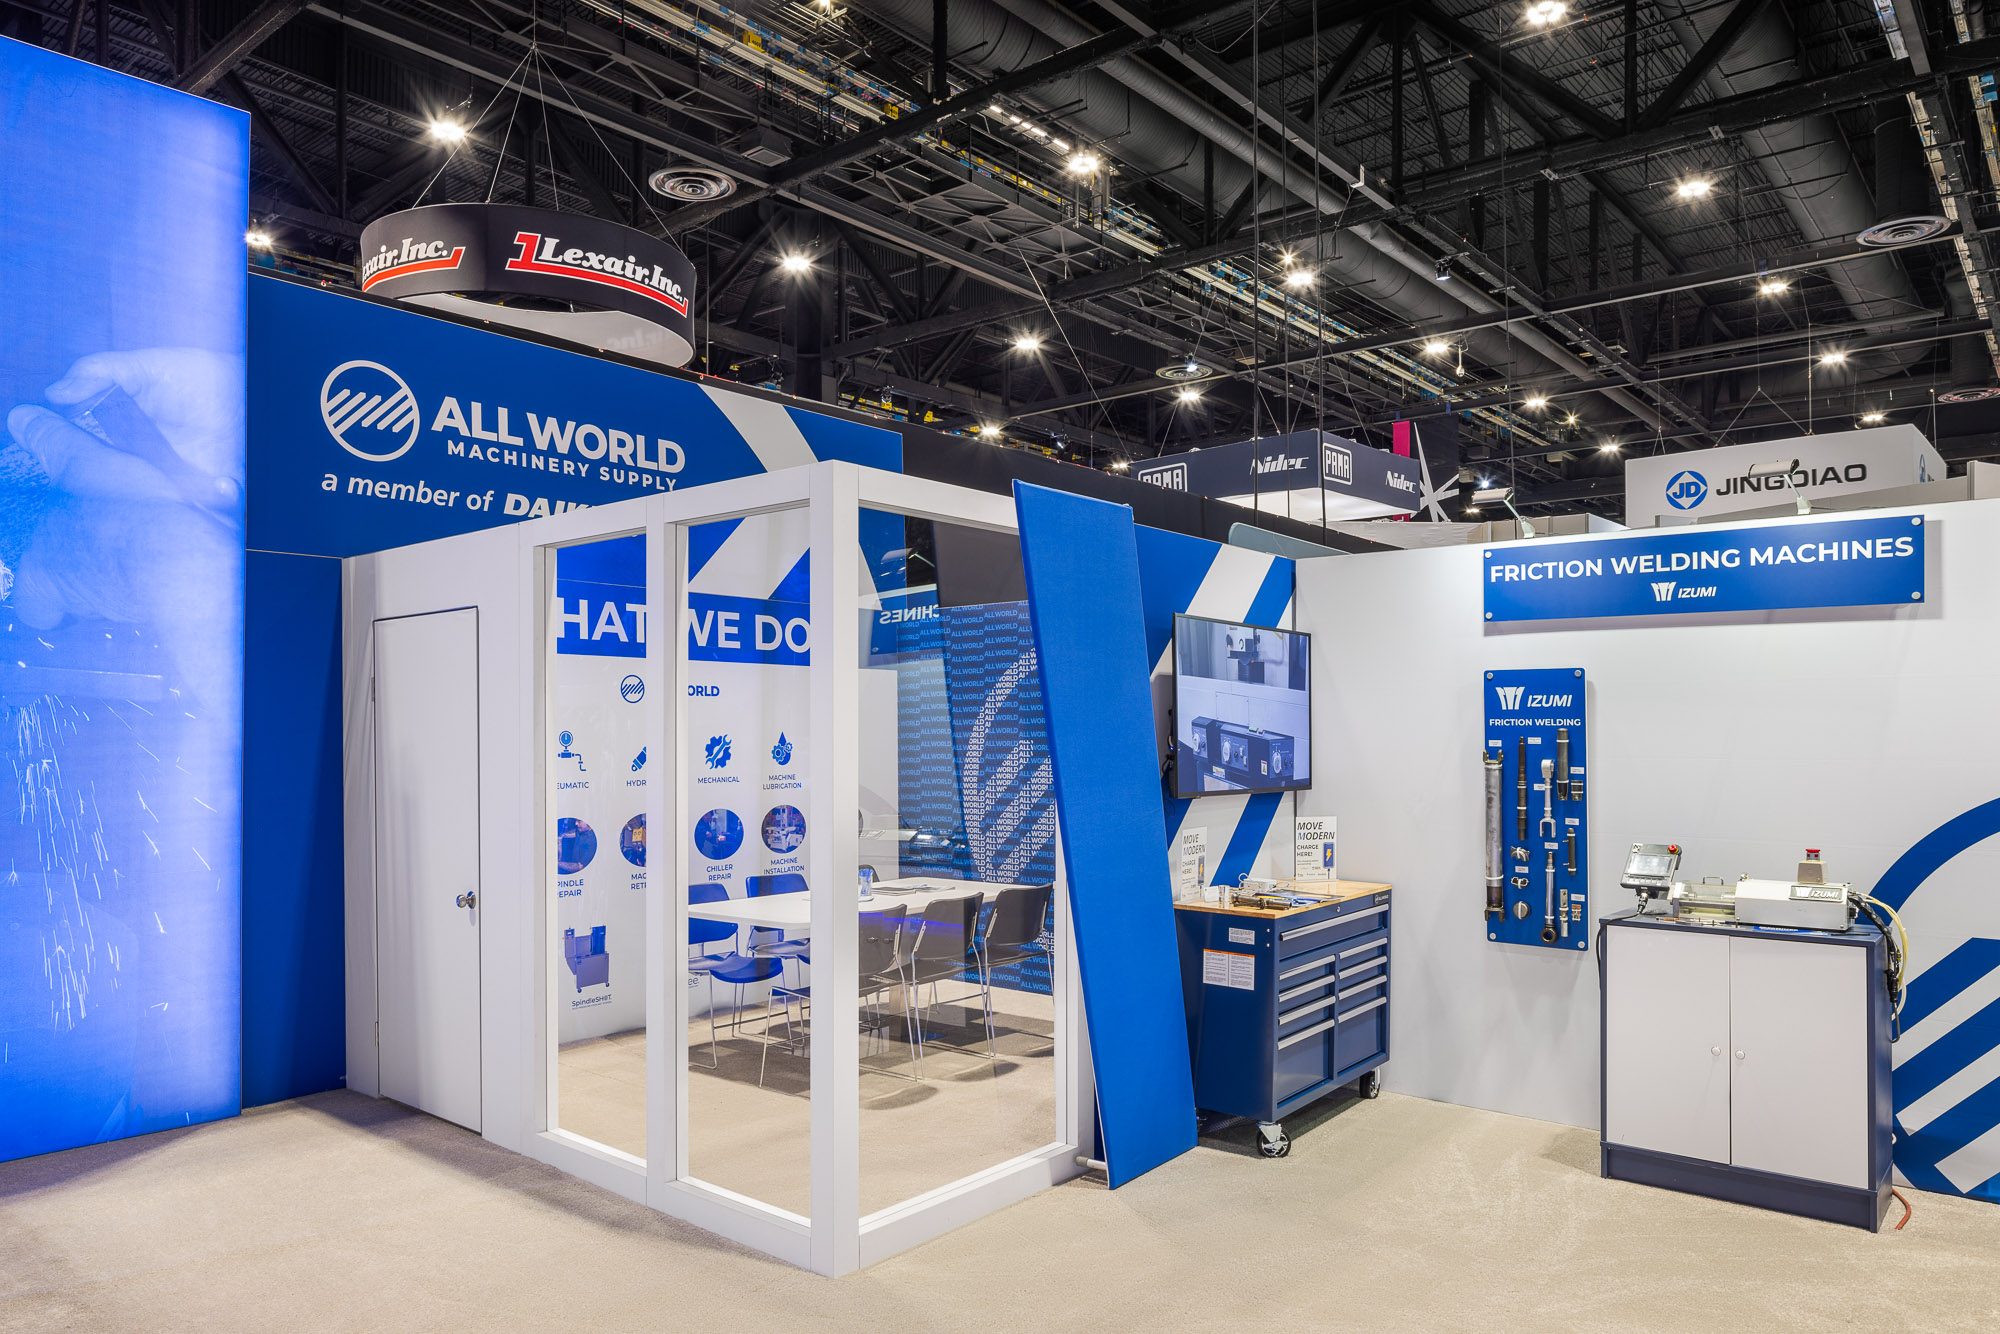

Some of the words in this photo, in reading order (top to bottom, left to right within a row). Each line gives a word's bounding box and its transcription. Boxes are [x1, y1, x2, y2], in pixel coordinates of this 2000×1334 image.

[431, 395, 523, 446] ALL
[526, 412, 686, 473] WORLD
[447, 439, 590, 477] MACHINERY
[599, 466, 677, 491] SUPPLY
[1250, 453, 1309, 475] Nidec
[1325, 450, 1349, 479] PAMA
[1385, 470, 1416, 493] Nidec
[1672, 481, 1701, 499] JD
[1716, 463, 1867, 496] JINGDIAO
[321, 473, 338, 490] a
[347, 475, 460, 507] member
[466, 490, 496, 511] of
[1490, 558, 1602, 583] FRICTION
[1610, 549, 1740, 575] WELDING
[1750, 536, 1914, 566] MACHINES
[1678, 586, 1717, 598] IZUMI
[755, 614, 810, 653] DO
[1527, 694, 1572, 708] IZUMI
[1490, 718, 1532, 726] FRICTION
[1534, 718, 1581, 726] WELDING
[762, 782, 802, 790] LUBRICATION
[1297, 822, 1323, 830] MOVE
[1183, 834, 1199, 844] MOVE
[1297, 832, 1335, 840] MODERN
[770, 857, 798, 866] MACHINE
[706, 864, 733, 872] CHILLER
[764, 865, 804, 875] INSTALLATION
[708, 873, 732, 882] REPAIR
[1811, 889, 1838, 898] IZUMI
